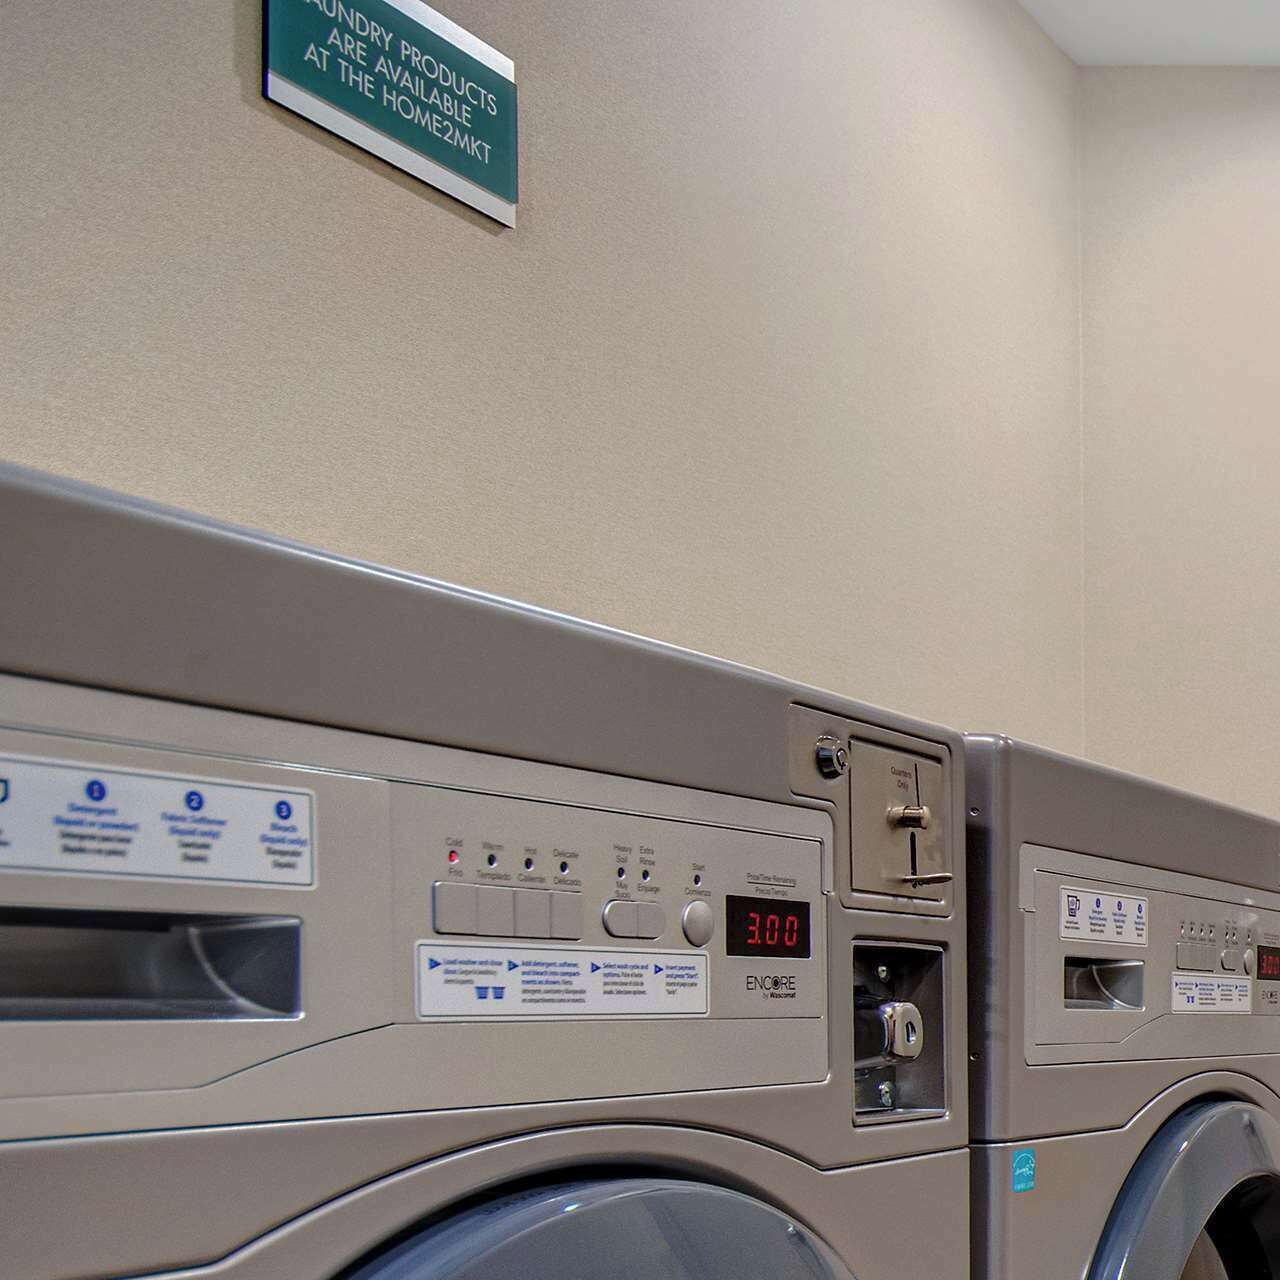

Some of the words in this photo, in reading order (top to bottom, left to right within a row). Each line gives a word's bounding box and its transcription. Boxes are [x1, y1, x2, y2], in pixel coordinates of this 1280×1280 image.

[304, 43, 330, 72] AT
[337, 59, 375, 98] THE
[383, 85, 491, 165] HOME2MKT
[305, 0, 392, 51] UNDRY
[401, 40, 497, 116] PRODUCTS
[328, 27, 367, 66] ARE
[375, 55, 471, 128] AVAILABLE
[746, 976, 796, 990] ENCORE
